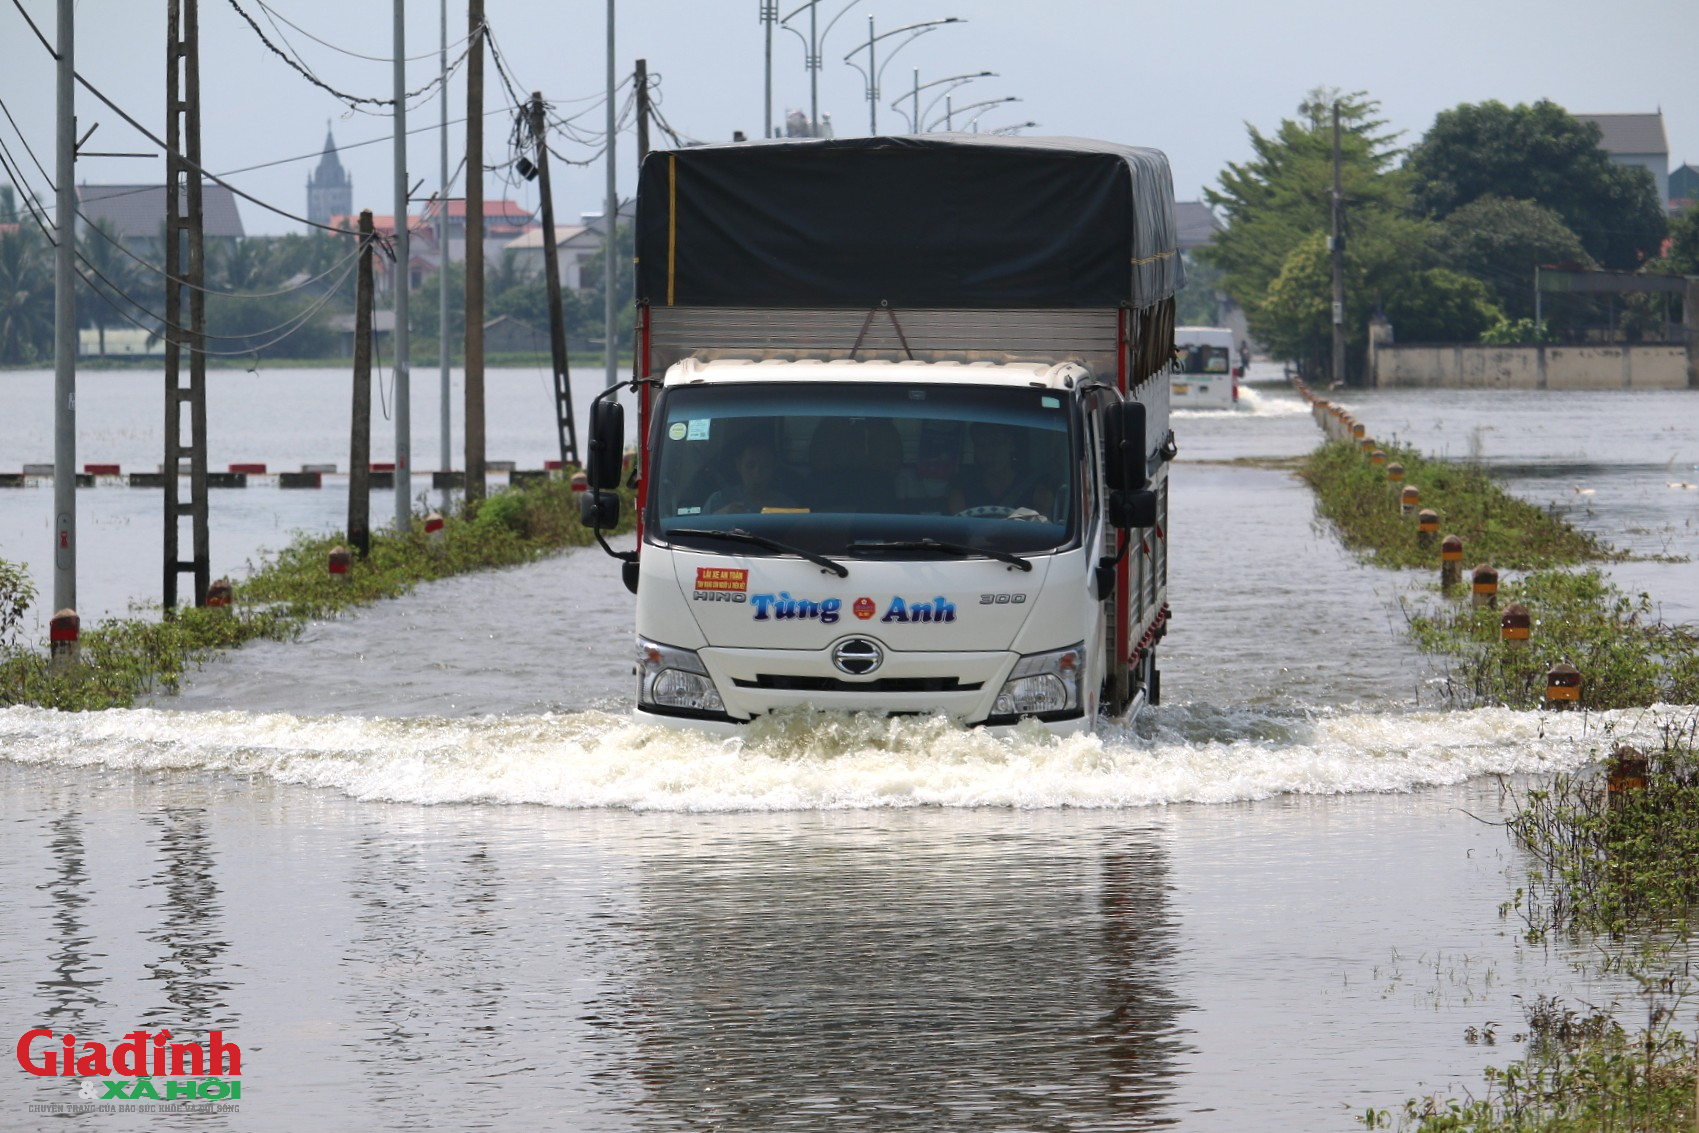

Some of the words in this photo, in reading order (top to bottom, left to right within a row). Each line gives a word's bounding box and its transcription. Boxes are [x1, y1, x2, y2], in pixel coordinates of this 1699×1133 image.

[693, 591, 747, 603] HINO
[979, 594, 1027, 604] 300
[750, 591, 843, 624] Tùng
[880, 595, 958, 624] Anh
